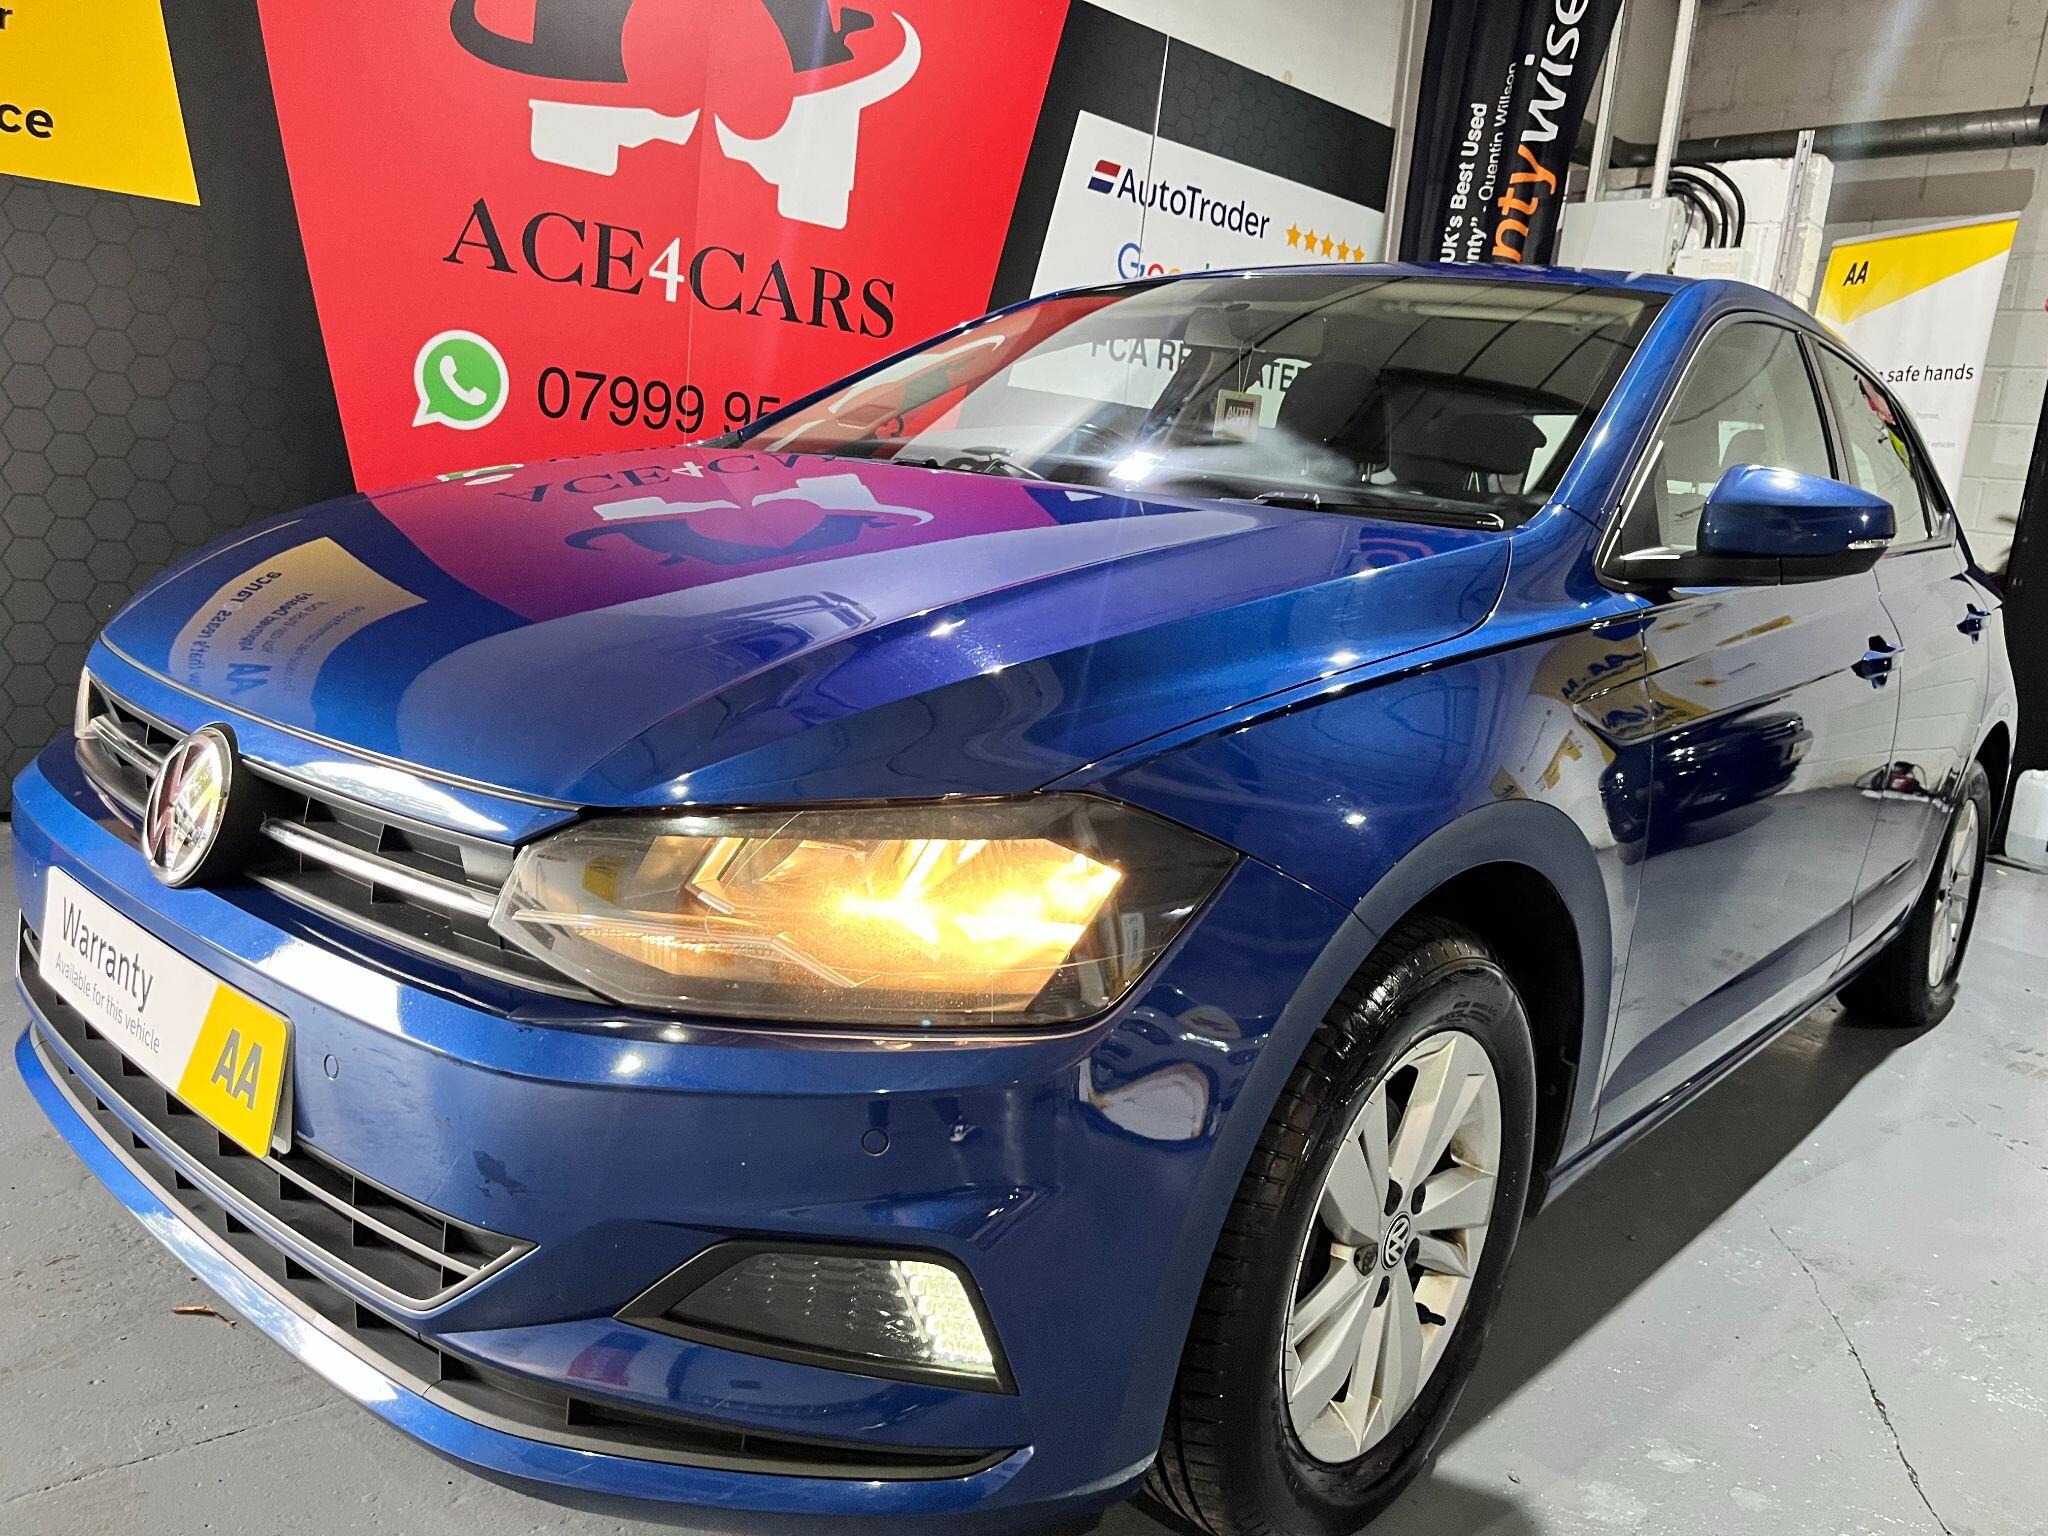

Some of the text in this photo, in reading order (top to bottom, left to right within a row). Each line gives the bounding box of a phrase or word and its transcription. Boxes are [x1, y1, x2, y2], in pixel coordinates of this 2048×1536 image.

[1461, 103, 1488, 157] Used
[1466, 216, 1488, 264] nty"
[1478, 132, 1504, 200] Quentin
[1493, 62, 1517, 127] Willson
[1116, 168, 1271, 239] AutoTrader
[1450, 161, 1475, 210] Best
[442, 197, 896, 338] ACE4CARS
[1843, 261, 1869, 286] AA
[537, 367, 705, 434] 07999
[1887, 363, 1974, 382] safe hands
[61, 896, 154, 1013] Warranty
[55, 951, 161, 1054] Available for this vehicle
[210, 1028, 264, 1111] AA
